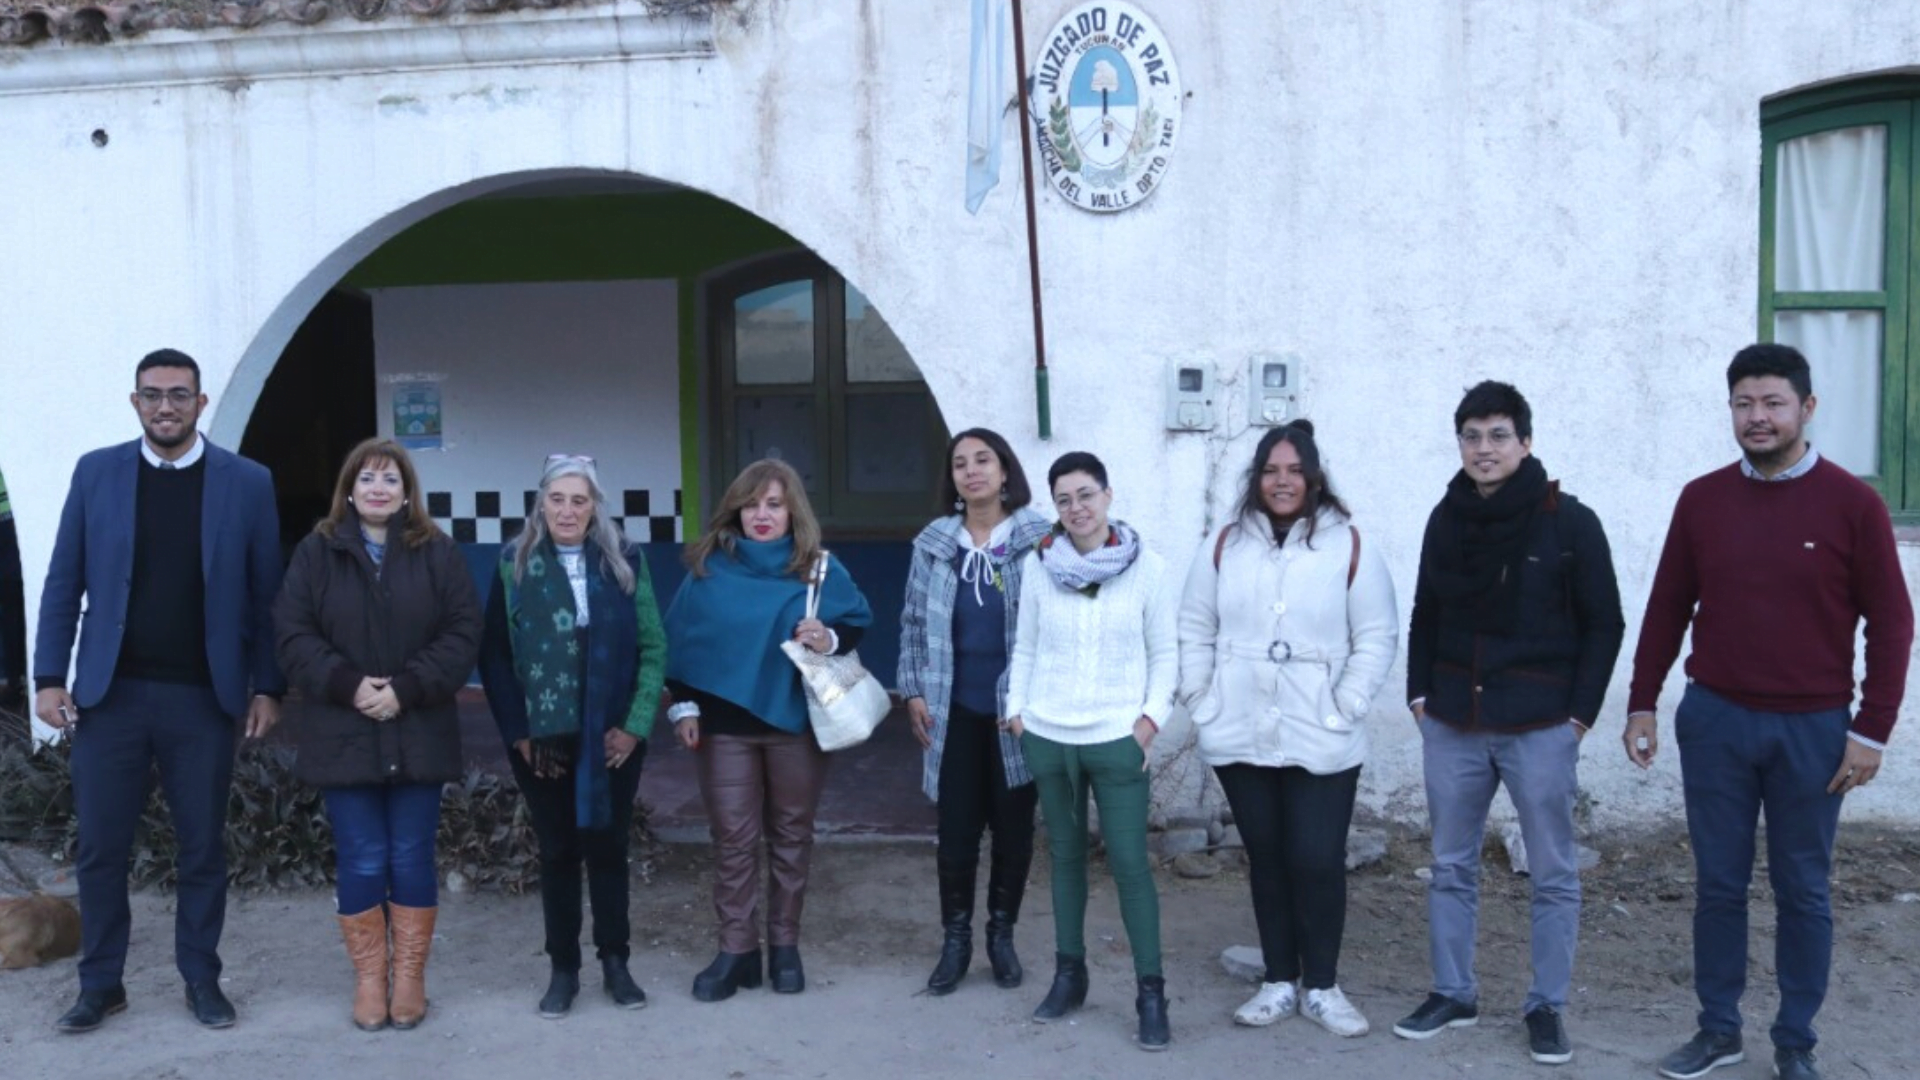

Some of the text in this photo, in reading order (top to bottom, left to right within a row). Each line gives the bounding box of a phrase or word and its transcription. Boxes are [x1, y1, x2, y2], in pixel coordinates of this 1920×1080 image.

[1039, 7, 1170, 94] JUZGADO DE PAZ
[1059, 176, 1081, 202] DEL
[1091, 190, 1130, 208] VALLE
[1136, 156, 1166, 194] DPTO
